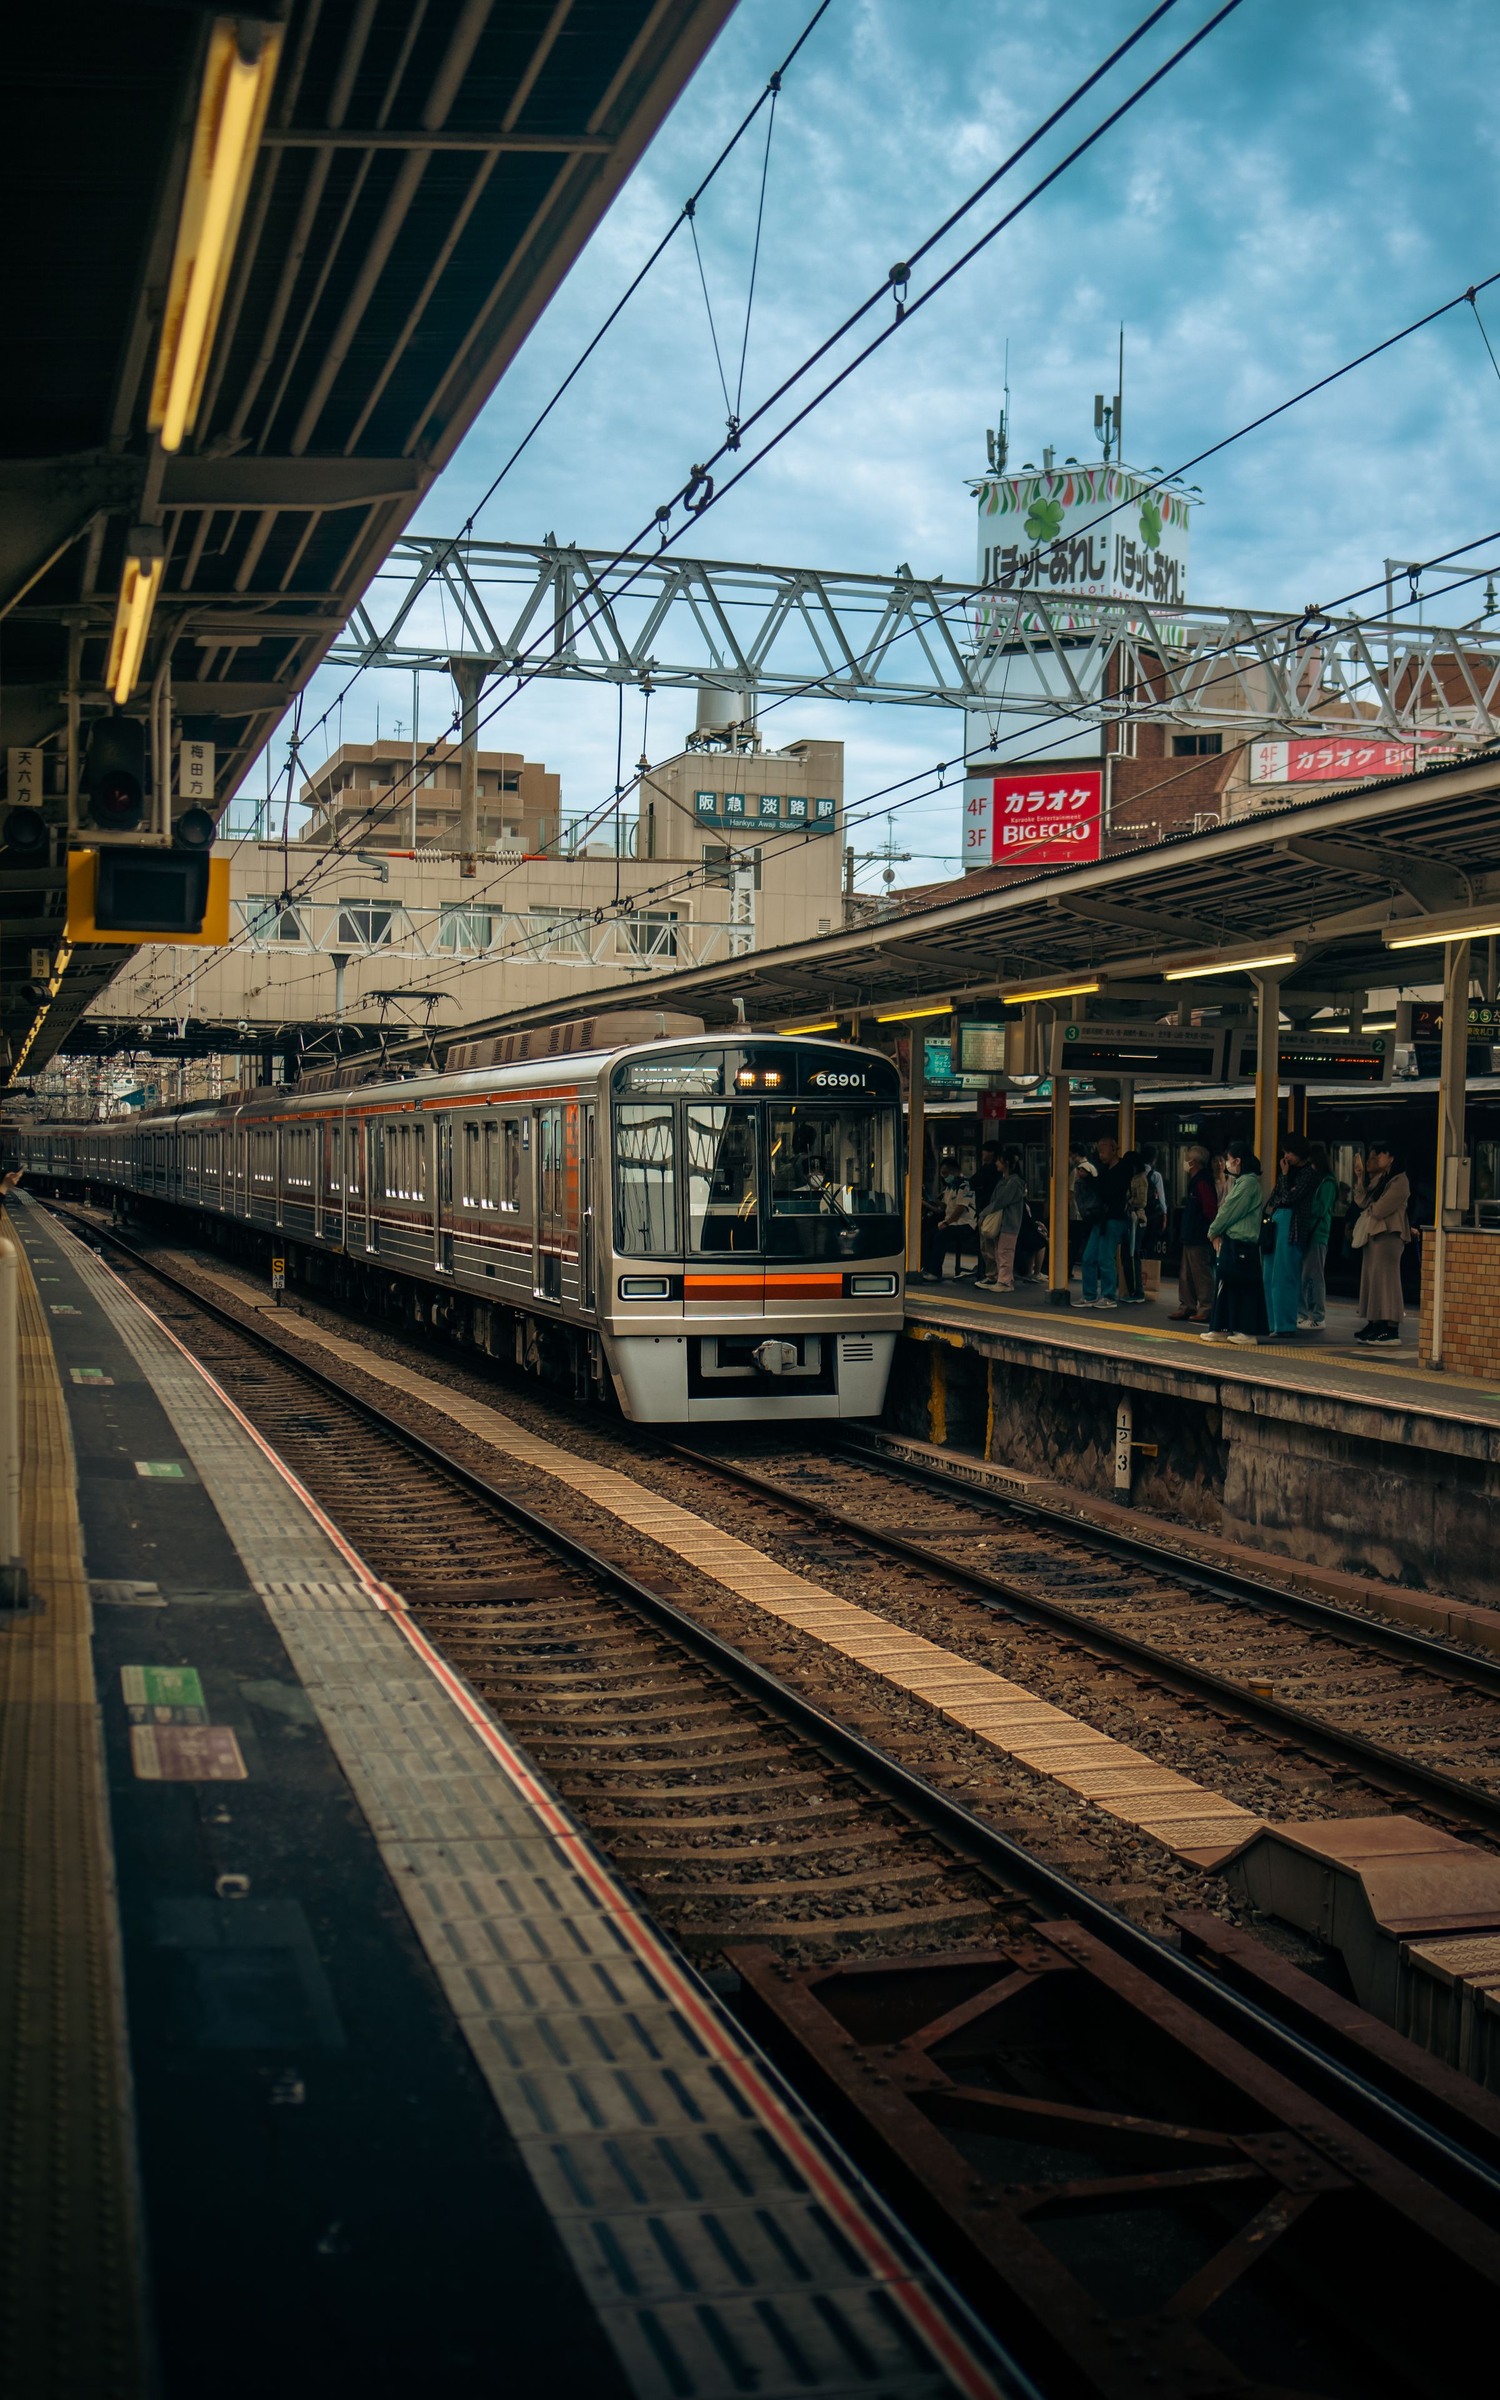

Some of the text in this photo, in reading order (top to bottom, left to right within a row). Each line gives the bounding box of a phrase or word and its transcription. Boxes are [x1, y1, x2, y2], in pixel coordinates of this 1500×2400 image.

[1259, 746, 1278, 763] 4F
[1296, 748, 1376, 770] カラオケ
[17, 751, 32, 803] 天六方
[190, 744, 204, 795] 梅田方
[1260, 764, 1278, 781] 3F
[699, 794, 833, 817] 阪急淡路駅
[967, 797, 987, 816] 4F
[1004, 789, 1091, 814] カラオケ
[729, 818, 755, 829] Hankyu
[758, 820, 776, 830] Awaji
[1036, 814, 1081, 823] Entertainment
[966, 829, 987, 847] 3F
[1003, 821, 1090, 845] BIG ECHO
[1068, 1027, 1076, 1039] 3
[1375, 1040, 1382, 1051] 2
[816, 1073, 866, 1087] 66901
[274, 1260, 283, 1273] S
